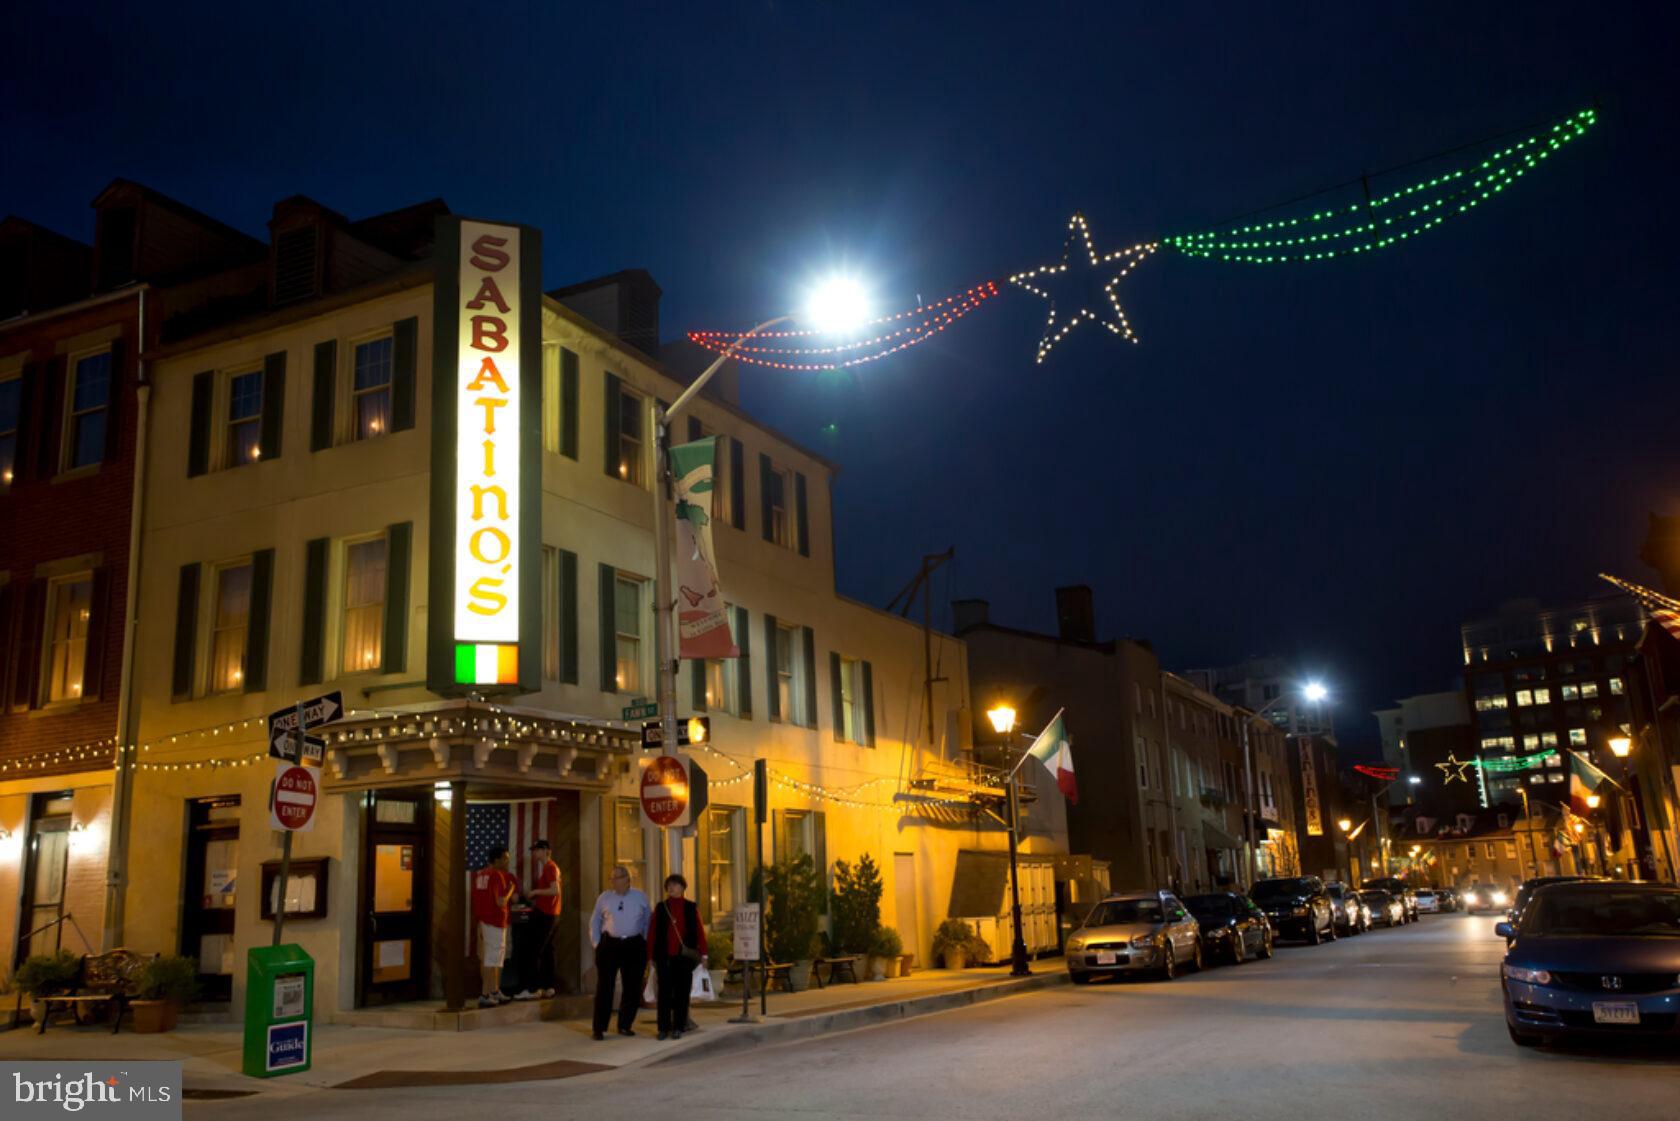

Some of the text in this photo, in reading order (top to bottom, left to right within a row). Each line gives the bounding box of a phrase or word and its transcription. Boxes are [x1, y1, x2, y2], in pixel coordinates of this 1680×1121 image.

[466, 234, 511, 616] SABATINO'S
[282, 776, 312, 791] DO NOT
[648, 771, 660, 782] DO
[282, 806, 306, 817] ENTER
[651, 800, 679, 813] ENTER
[270, 1037, 304, 1053] Guide
